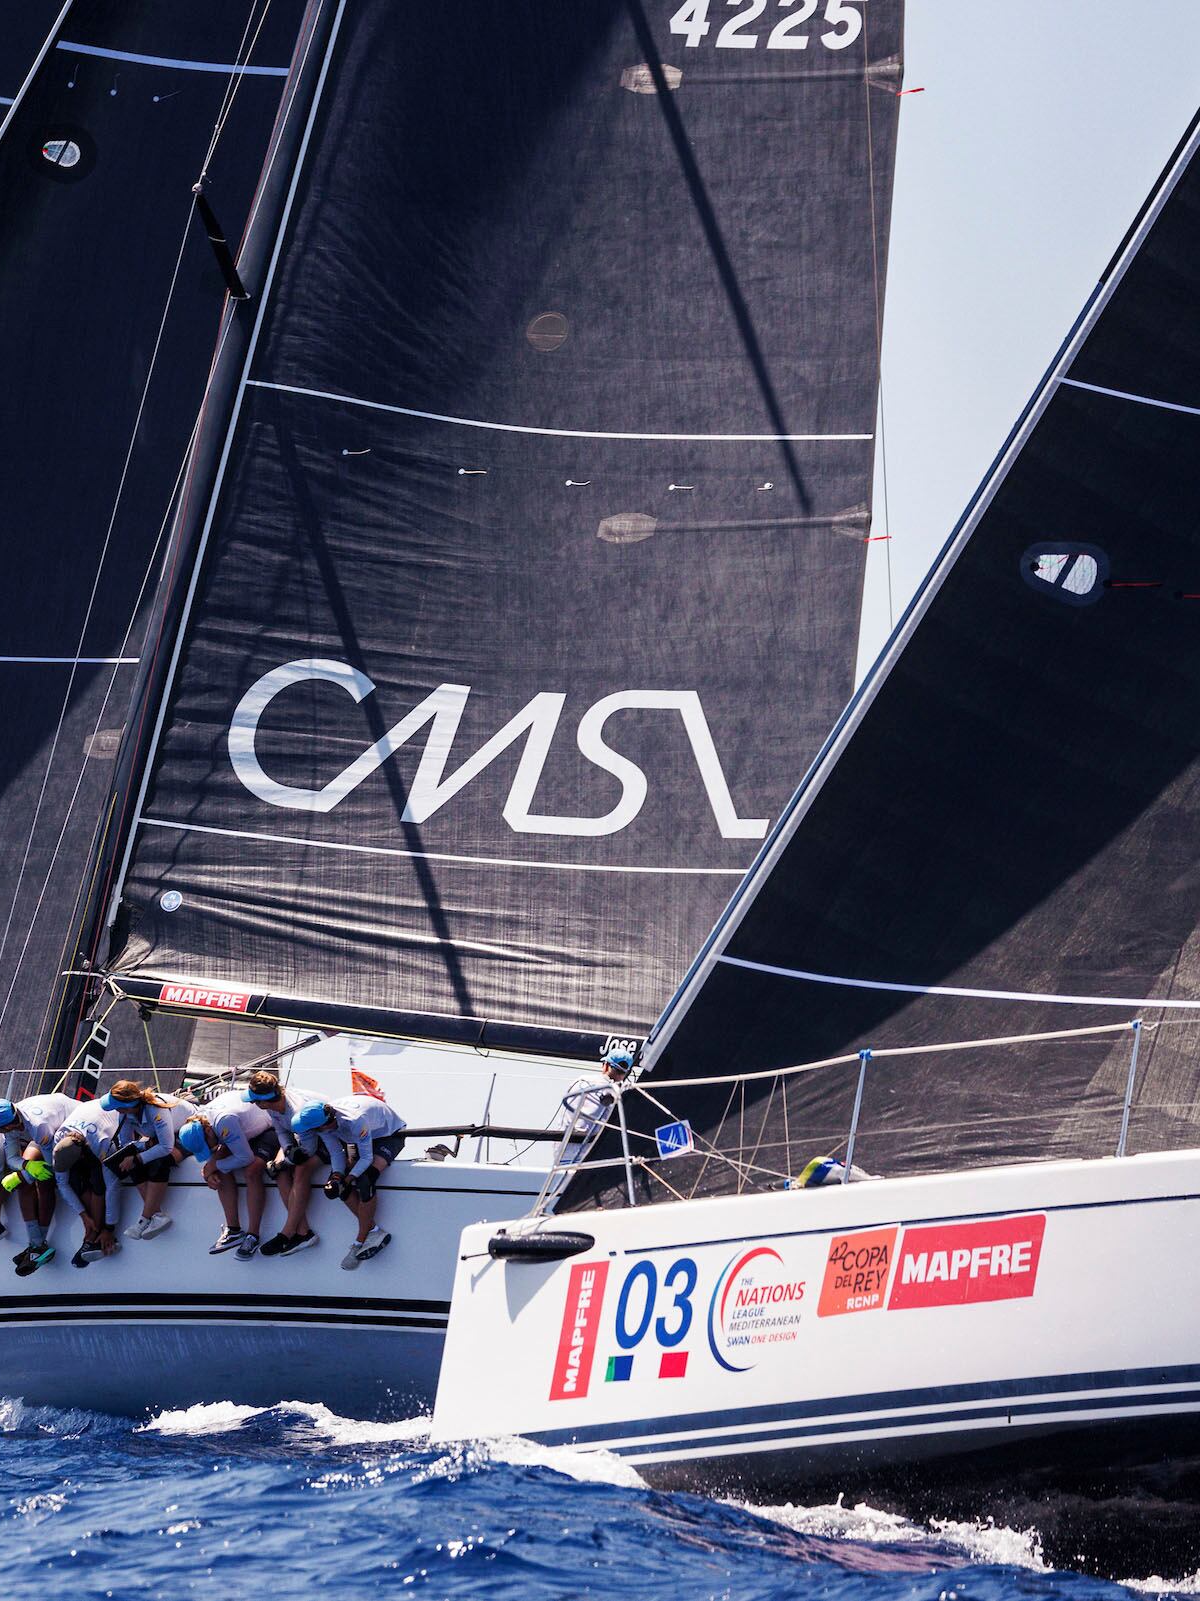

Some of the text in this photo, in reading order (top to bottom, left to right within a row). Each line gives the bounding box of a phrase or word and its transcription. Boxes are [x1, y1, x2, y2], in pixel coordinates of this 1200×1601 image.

[669, 0, 863, 50] 4225
[166, 987, 244, 1009] MAPFRE
[829, 1241, 888, 1272] 42 COPA
[901, 1240, 1033, 1285] MAPFRE
[736, 1281, 806, 1307] NATIONS
[741, 1278, 753, 1286] THE
[834, 1268, 887, 1294] DEL REY
[615, 1258, 698, 1350] 03
[732, 1307, 765, 1320] LEAGUE
[846, 1293, 879, 1310] RCNP
[563, 1268, 596, 1393] MAPFRE
[729, 1314, 801, 1332] MEDITERRANEAN
[726, 1331, 798, 1348] SWAN ONE DESIGN
